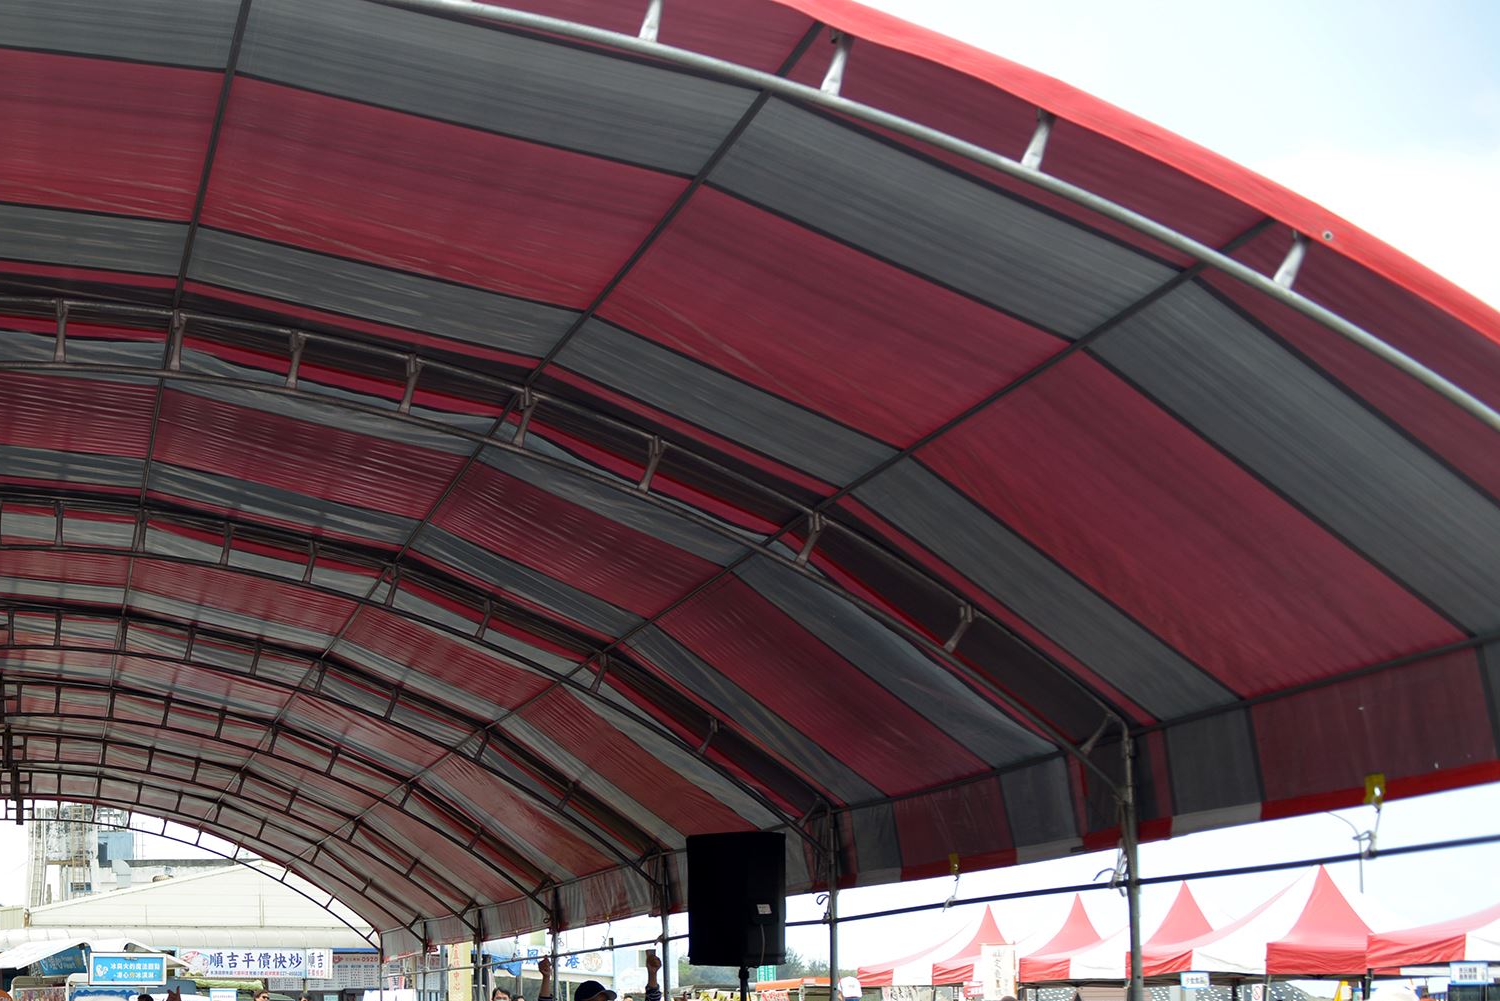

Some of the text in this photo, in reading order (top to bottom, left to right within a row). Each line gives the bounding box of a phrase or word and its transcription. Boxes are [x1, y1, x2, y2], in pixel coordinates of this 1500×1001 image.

[209, 952, 303, 969] 順吉平價快炒
[308, 952, 324, 968] 順吉
